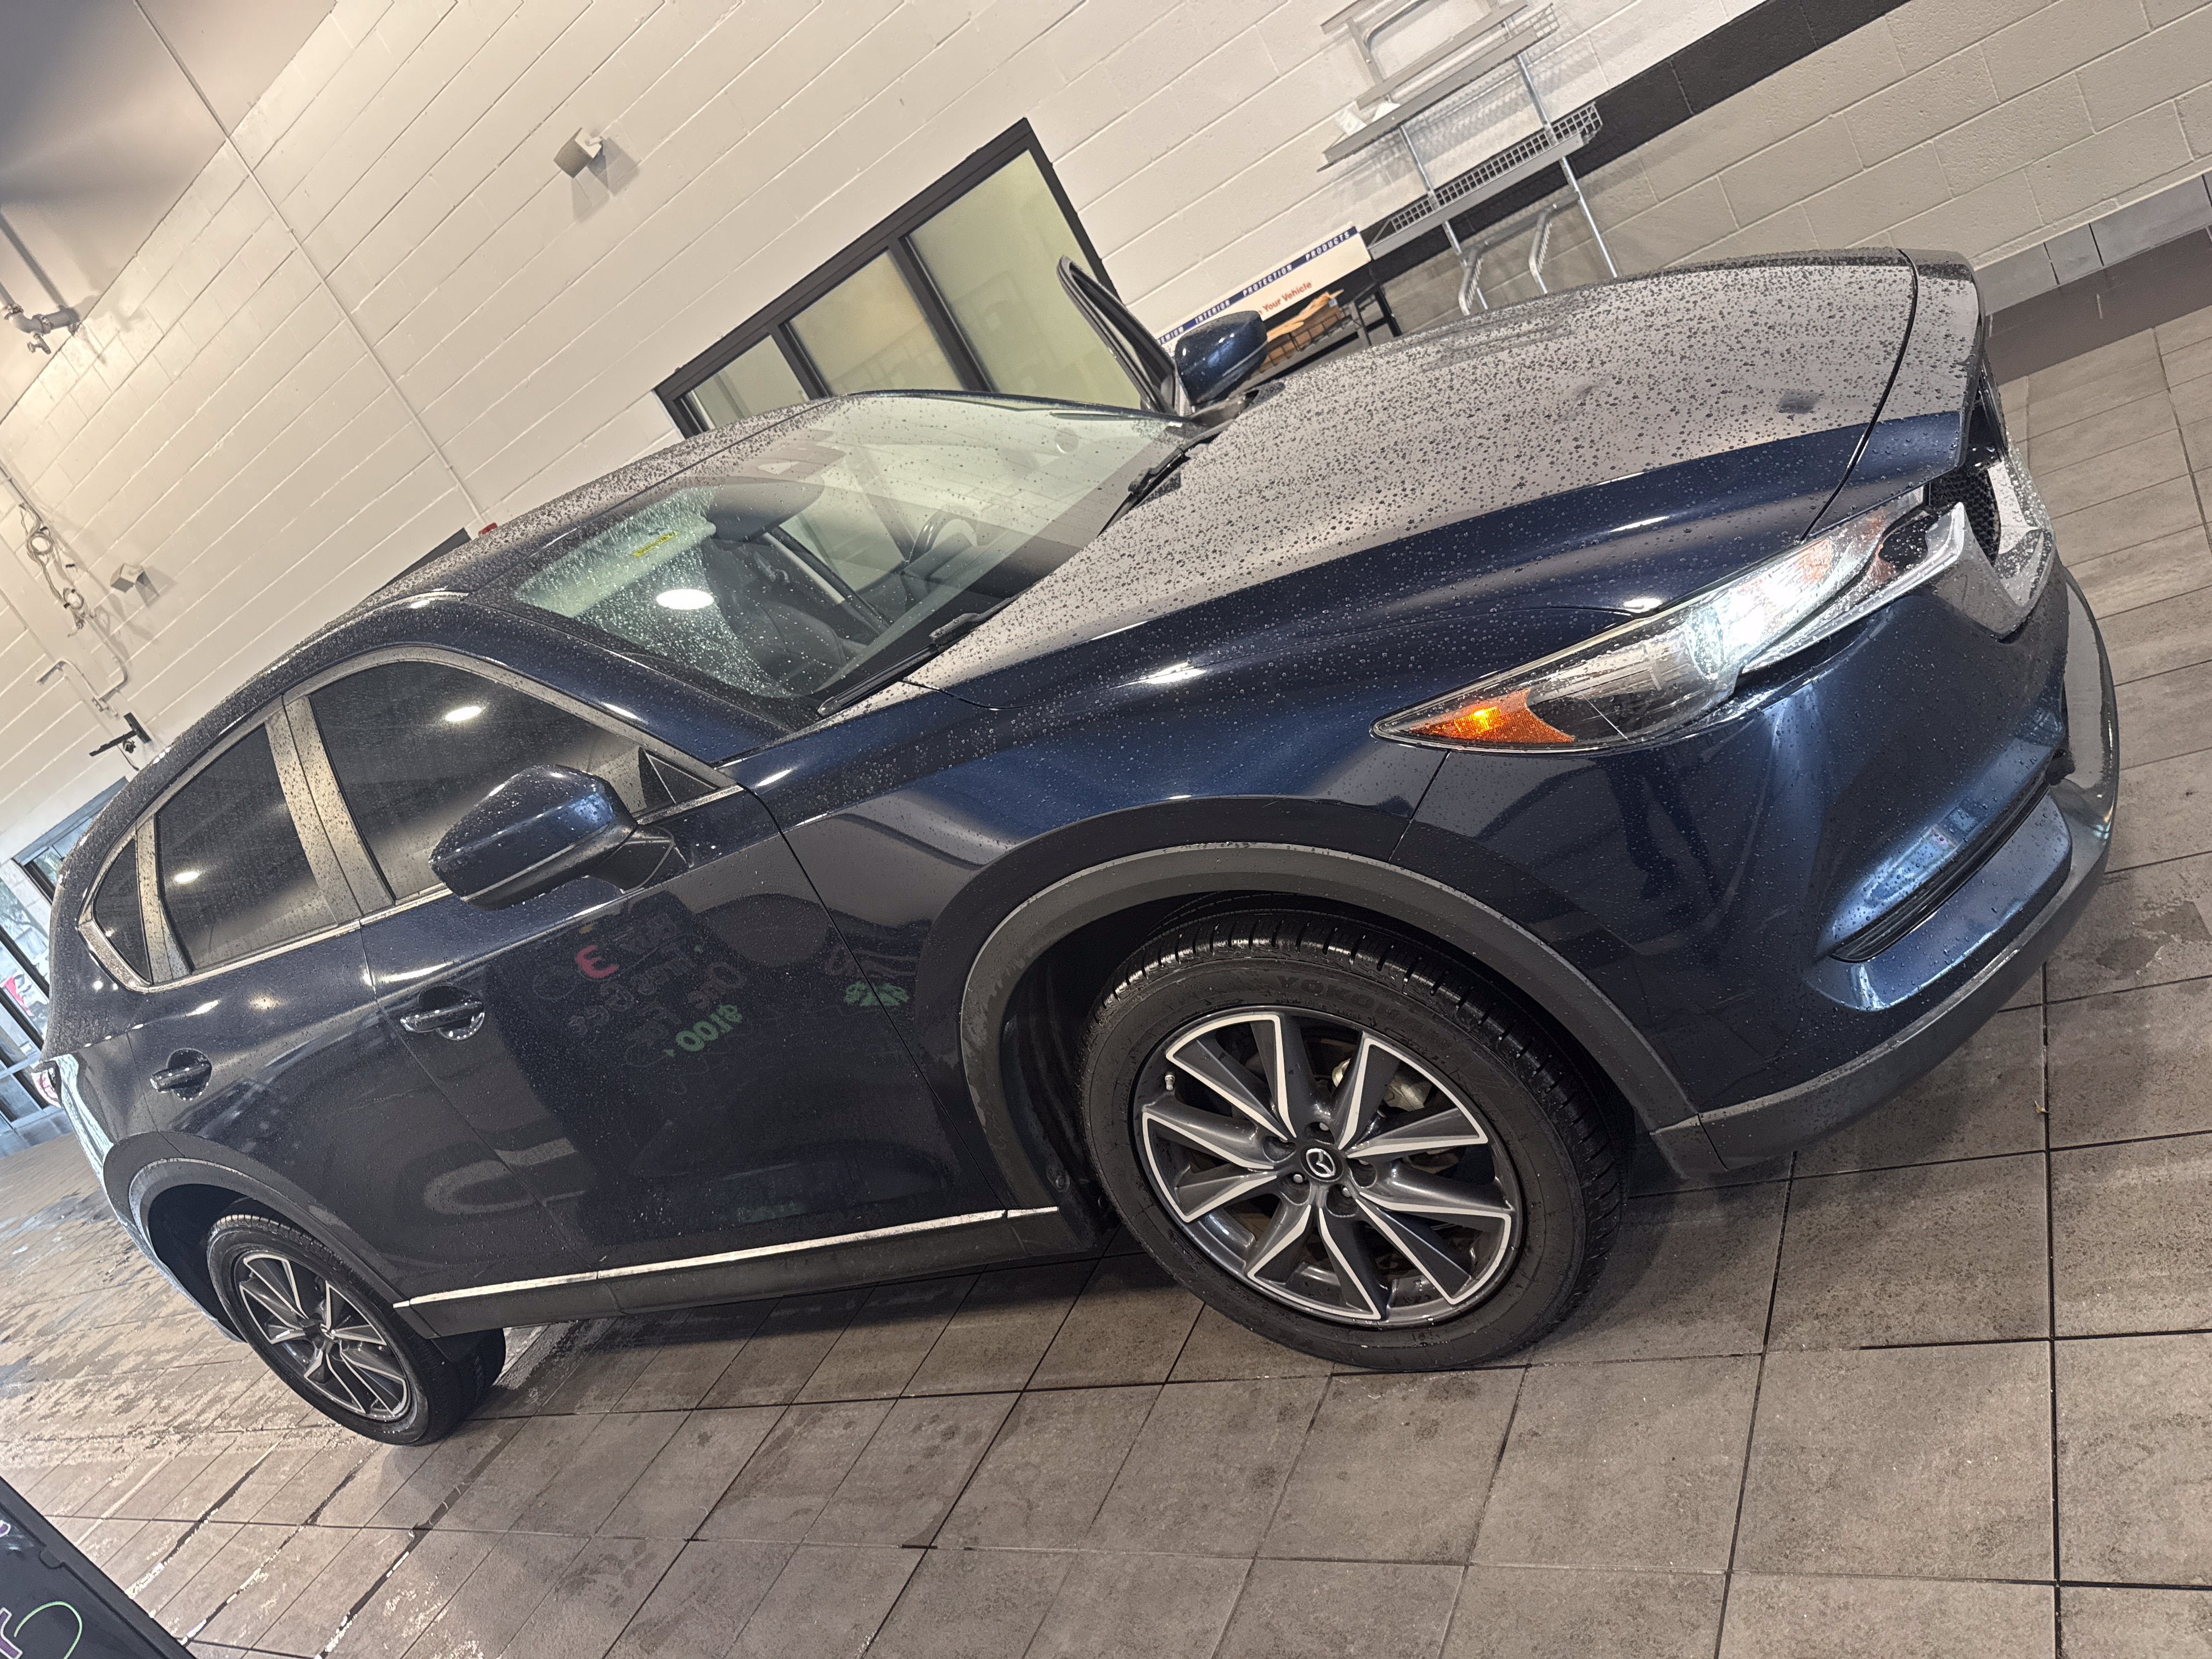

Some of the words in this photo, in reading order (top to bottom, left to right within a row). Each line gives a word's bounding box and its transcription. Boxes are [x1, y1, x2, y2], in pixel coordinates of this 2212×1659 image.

[1157, 326, 1184, 345] EMIUM
[1194, 300, 1229, 324] INTERIOR
[1242, 263, 1292, 297] PROTECTION
[1305, 231, 1350, 261] PRODUCTS
[1262, 298, 1282, 312] Your
[1282, 281, 1312, 302] Vehicle
